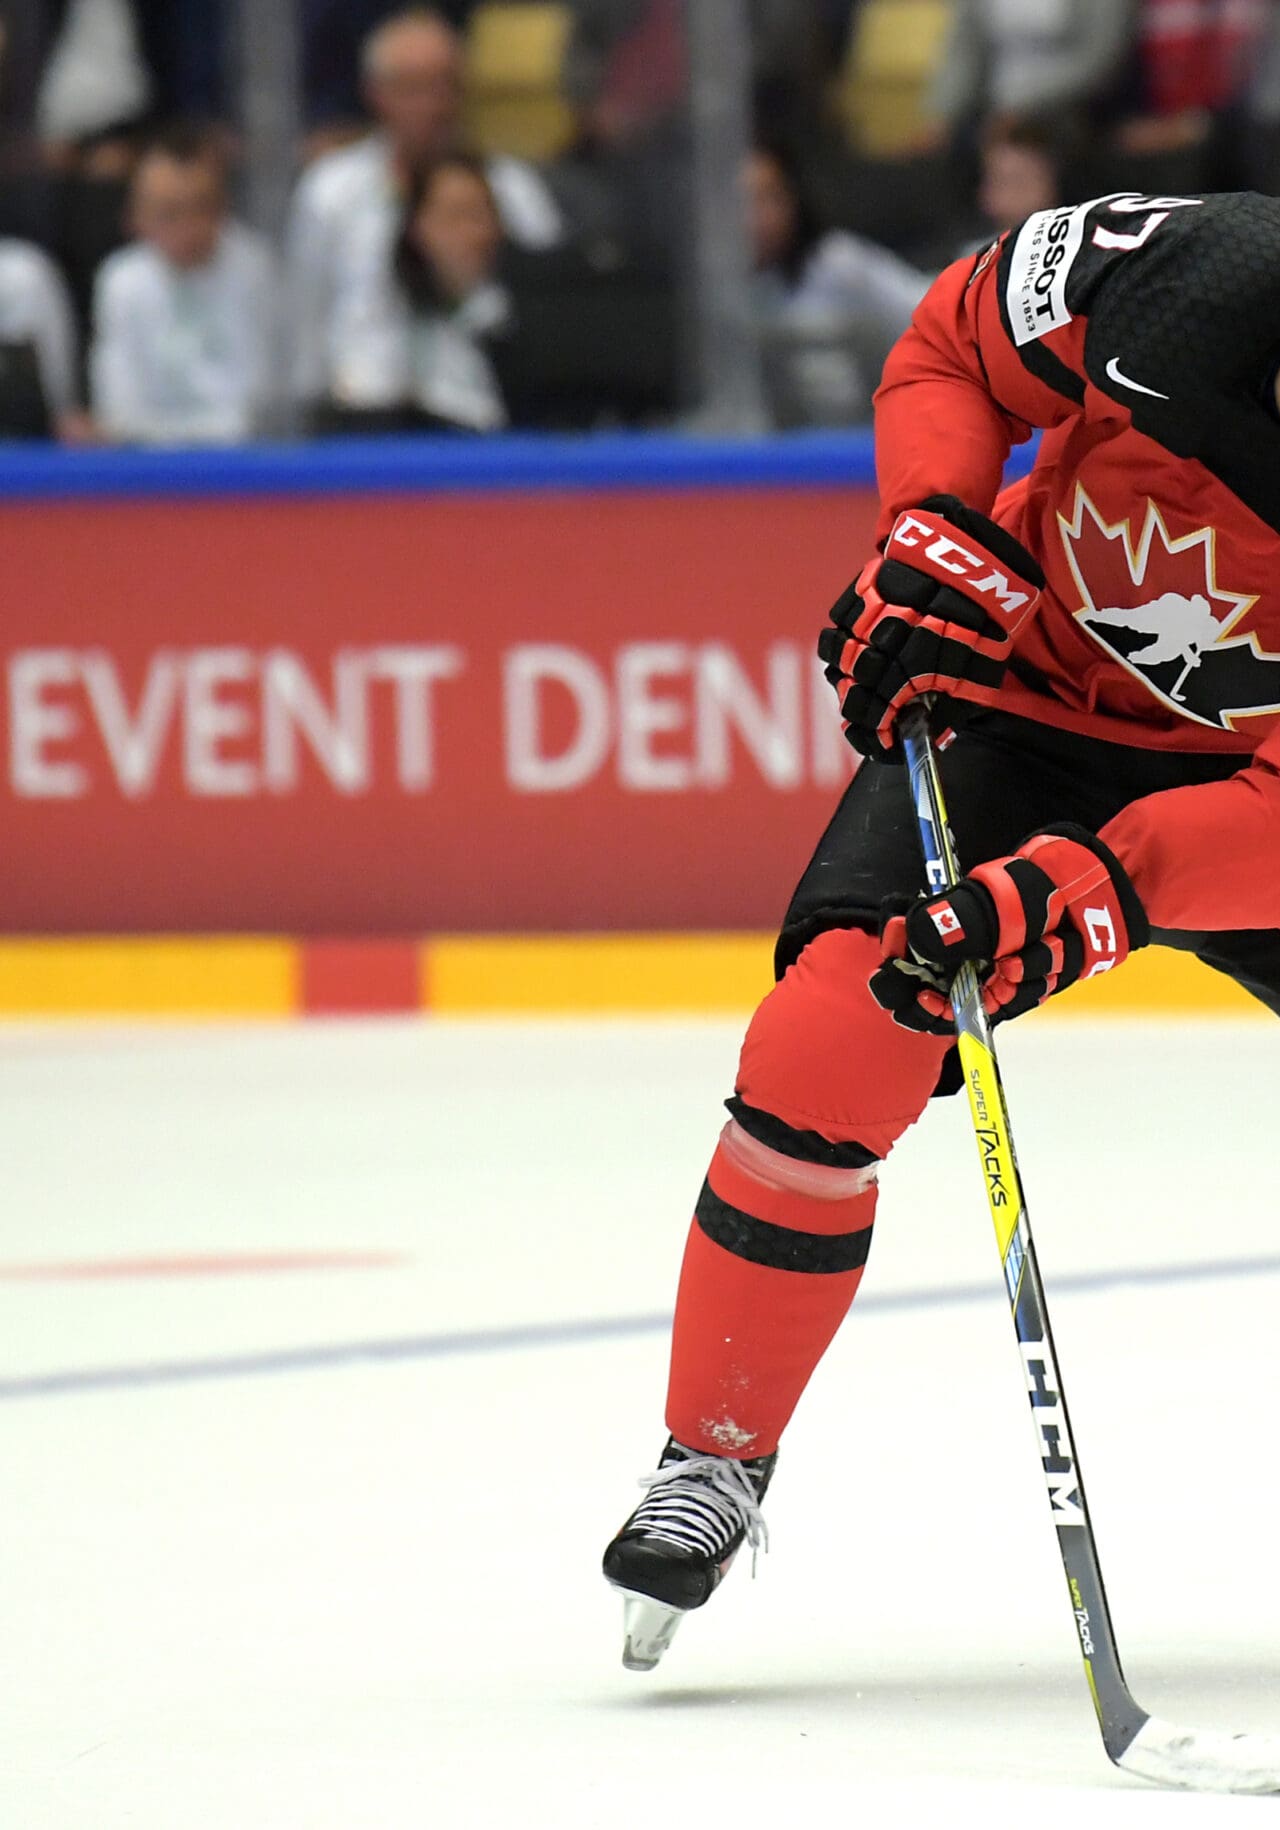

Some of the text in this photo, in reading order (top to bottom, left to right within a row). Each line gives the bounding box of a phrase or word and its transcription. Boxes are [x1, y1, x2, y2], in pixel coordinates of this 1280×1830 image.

[1021, 252, 1041, 293] SINCE
[1034, 206, 1075, 321] ISSOT
[1021, 298, 1037, 333] 1853
[893, 515, 1030, 613] CCM
[5, 639, 862, 799] EVENT DEN
[970, 1068, 988, 1121] SUPER
[975, 1121, 1010, 1208] TACKS
[1075, 1607, 1095, 1655] TACKS
